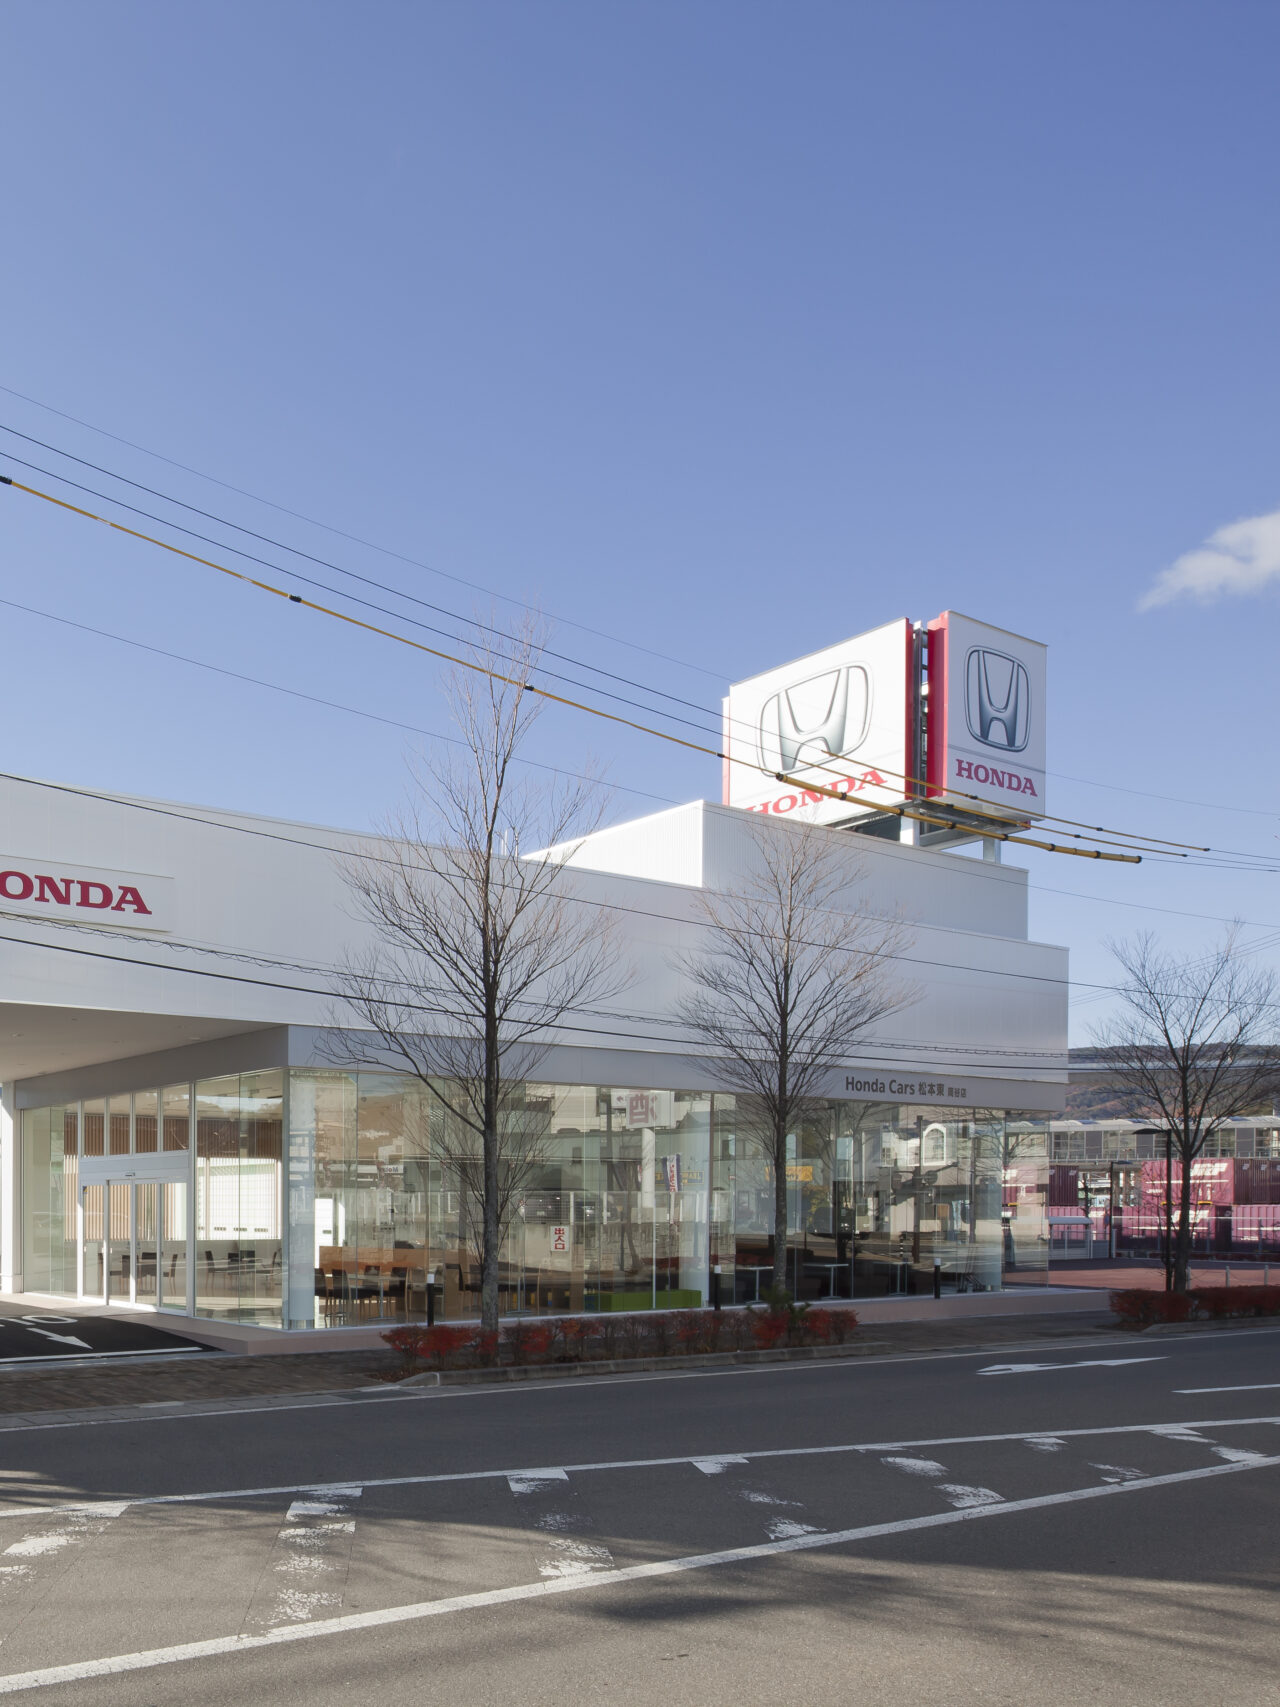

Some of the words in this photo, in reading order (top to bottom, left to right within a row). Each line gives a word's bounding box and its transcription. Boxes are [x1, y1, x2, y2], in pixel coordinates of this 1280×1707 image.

[955, 758, 1038, 797] HONDA
[846, 1076, 885, 1093] Honda
[888, 1080, 915, 1096] Cars
[918, 1082, 944, 1097] 松本東
